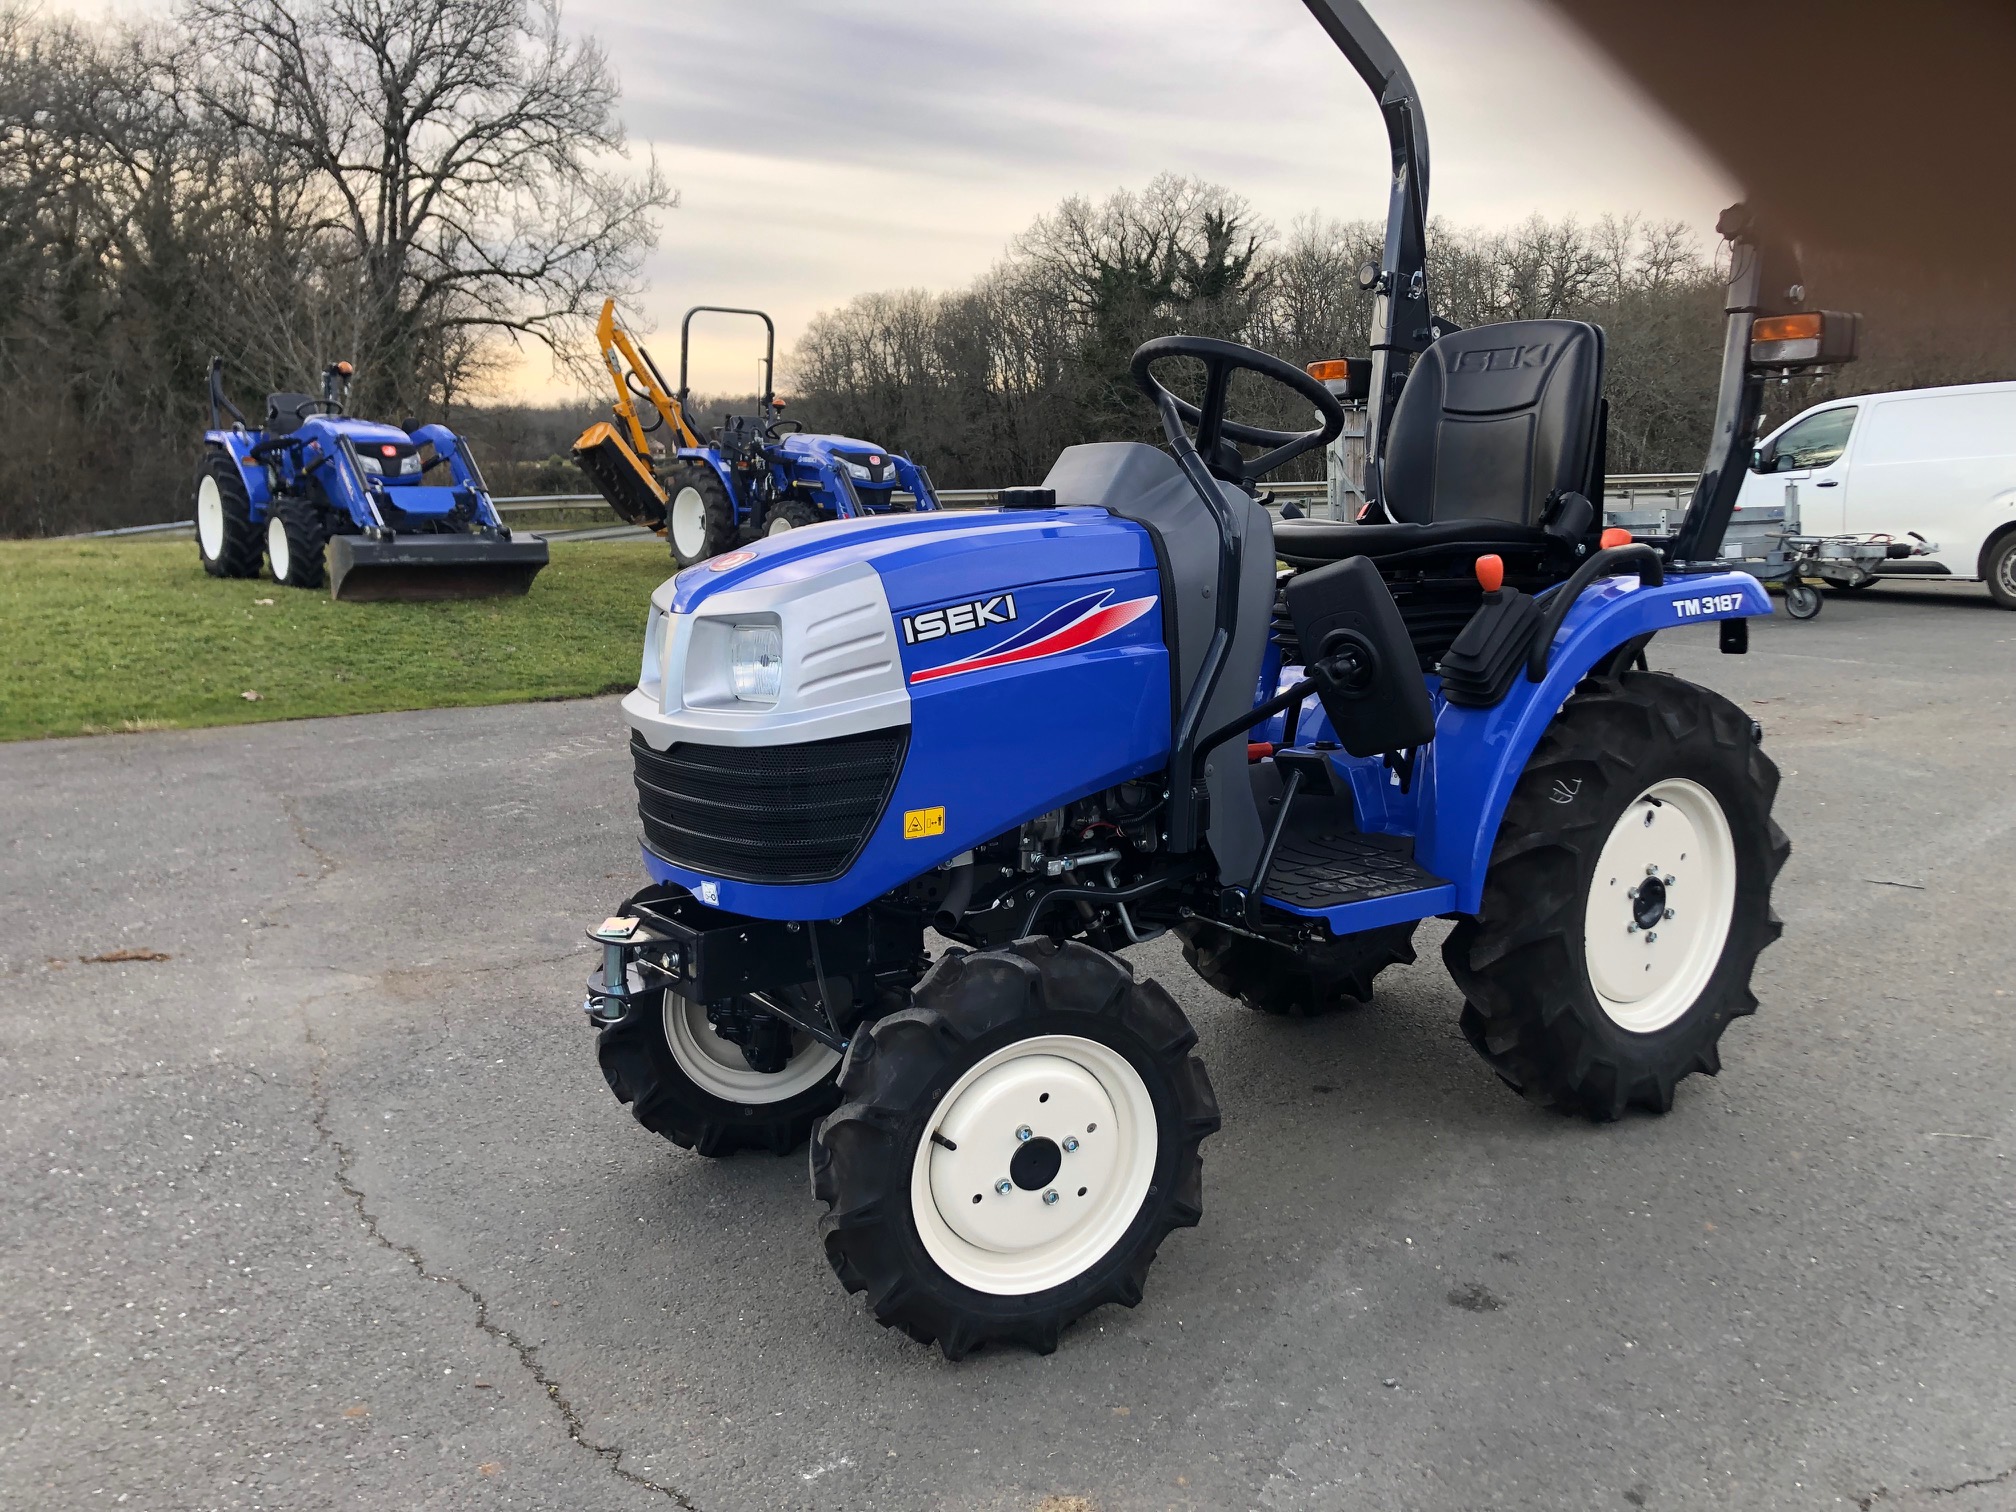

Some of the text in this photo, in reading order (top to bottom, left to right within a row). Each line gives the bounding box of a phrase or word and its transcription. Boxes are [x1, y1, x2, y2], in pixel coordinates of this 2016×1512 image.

[901, 593, 1018, 645] ISEKI
[1672, 593, 1743, 618] TM 3187
